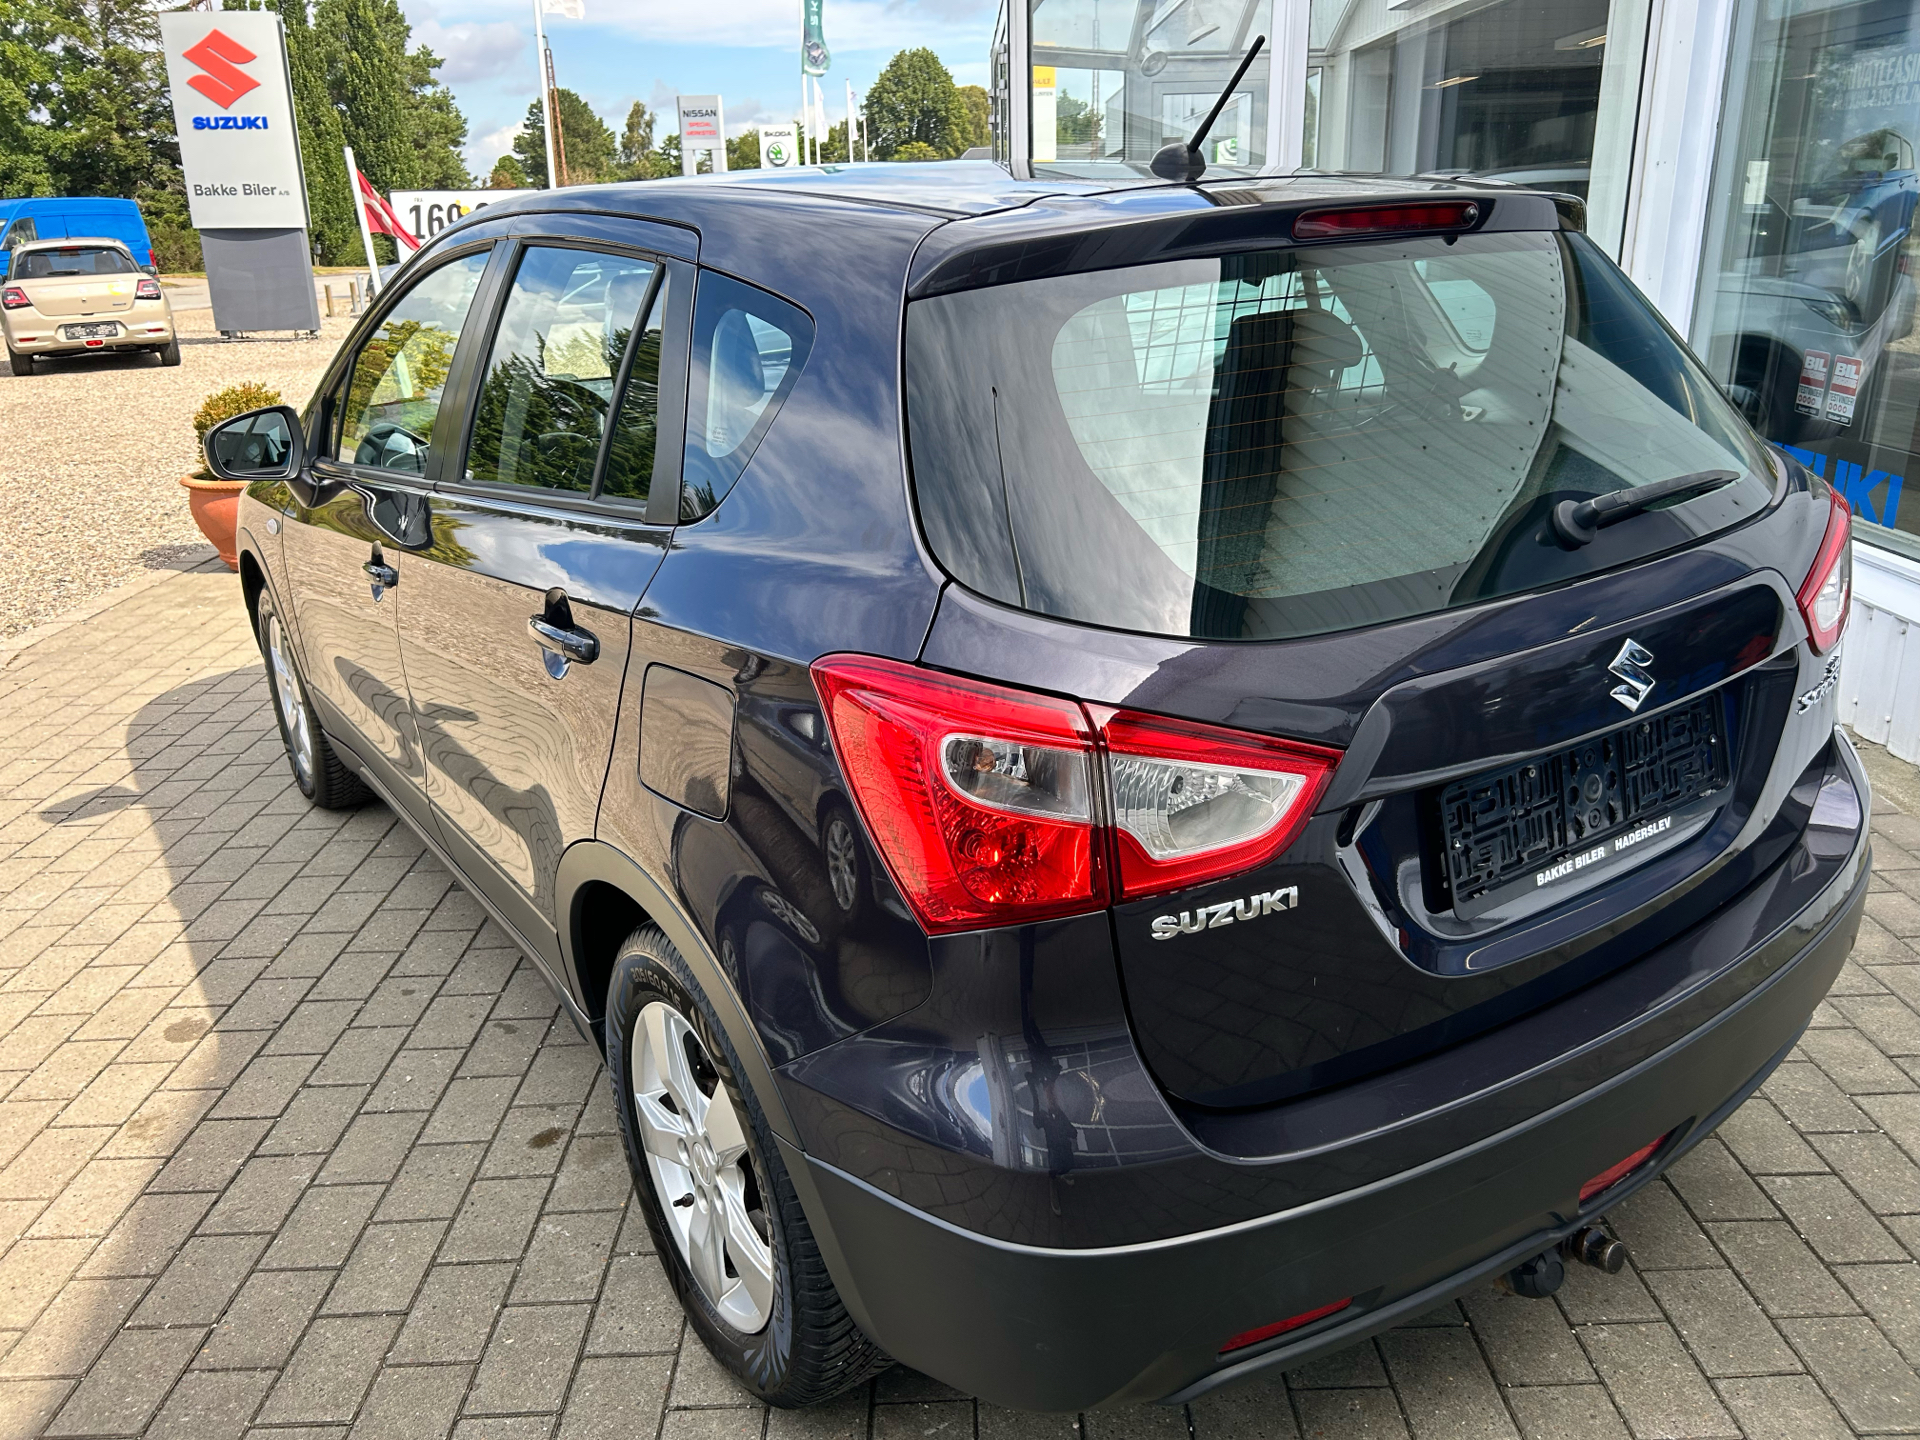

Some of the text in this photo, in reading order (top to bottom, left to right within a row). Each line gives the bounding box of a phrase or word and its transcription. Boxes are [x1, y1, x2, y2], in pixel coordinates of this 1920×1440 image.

[682, 109, 717, 118] NISSAN
[192, 116, 269, 130] SUZUKI
[193, 184, 237, 196] Bakke
[242, 183, 277, 196] Biler
[1804, 355, 1828, 372] BIL
[1834, 362, 1859, 379] BIL
[1536, 815, 1672, 887] BAKKE BILER HADERSLEV
[1151, 885, 1299, 941] SUZUKI
